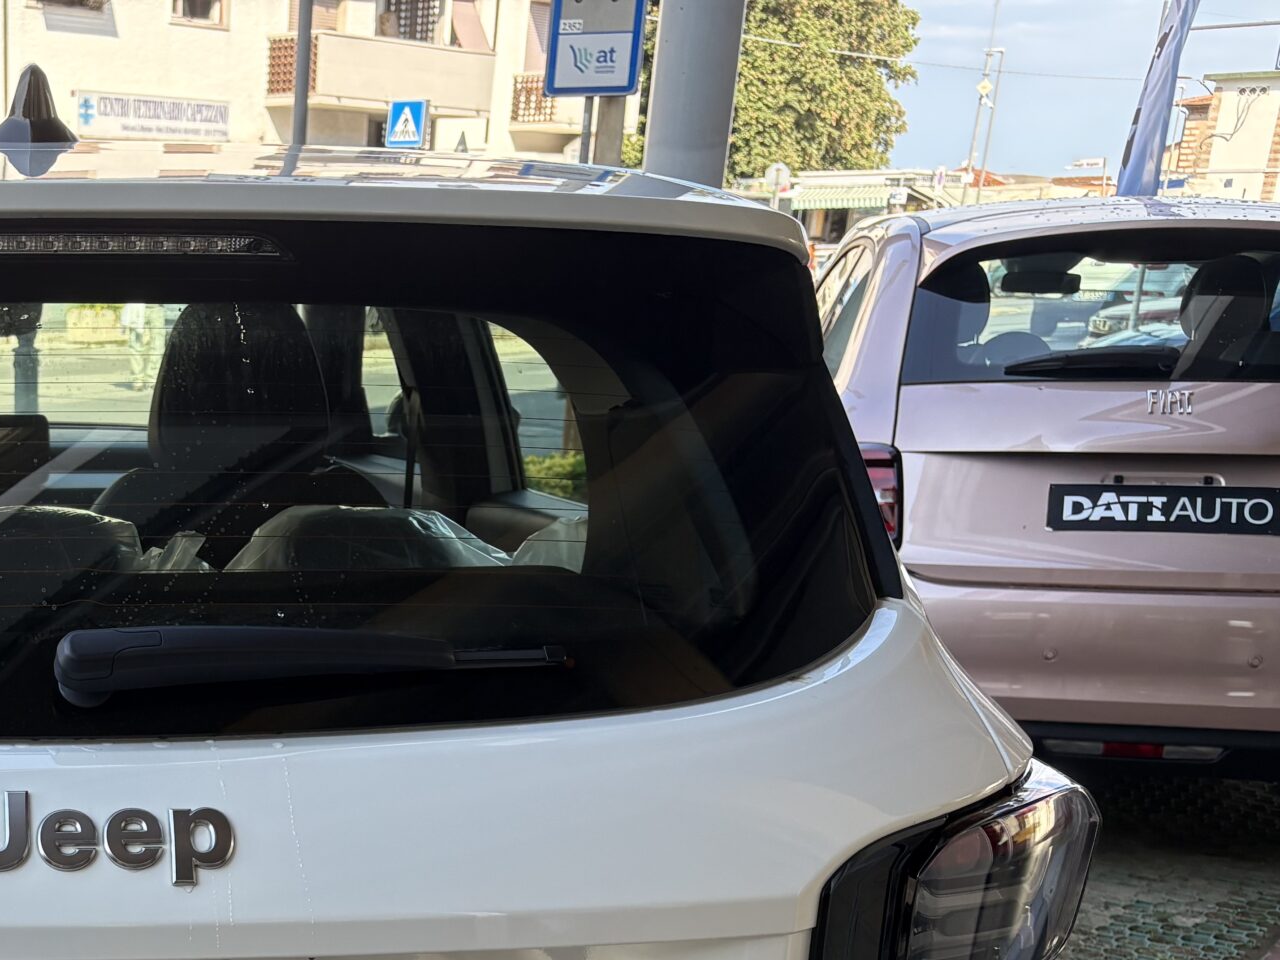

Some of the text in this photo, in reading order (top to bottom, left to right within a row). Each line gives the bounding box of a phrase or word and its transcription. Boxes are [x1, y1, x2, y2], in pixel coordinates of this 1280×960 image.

[596, 46, 616, 63] at
[97, 95, 131, 118] CENTRO
[132, 98, 186, 121] VETERINARIO
[1146, 389, 1194, 415] FIAT
